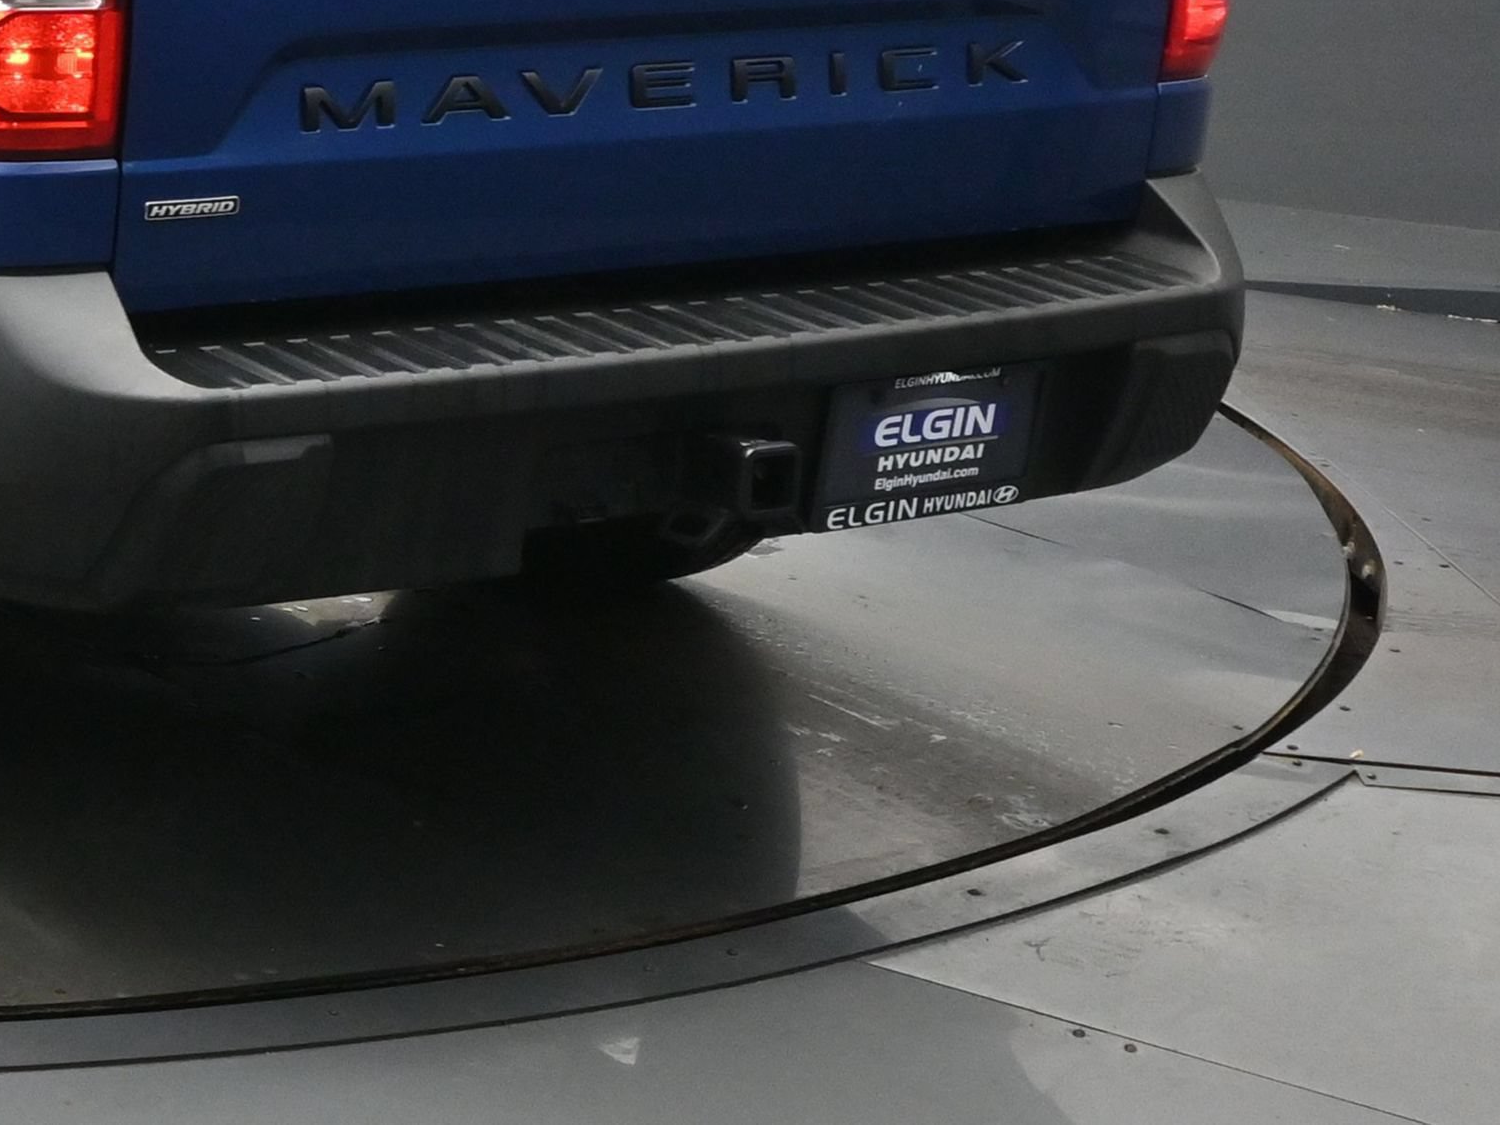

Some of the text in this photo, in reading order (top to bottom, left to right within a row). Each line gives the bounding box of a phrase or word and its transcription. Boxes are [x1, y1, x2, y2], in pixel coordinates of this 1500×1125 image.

[301, 40, 1029, 133] MAVERICK
[149, 201, 235, 217] HYBRID
[874, 404, 997, 447] ELGIN
[877, 444, 984, 472] HYUNDAI
[875, 467, 979, 491] ElginHyundai.com
[827, 489, 992, 531] ELGIN HYUNDAI
